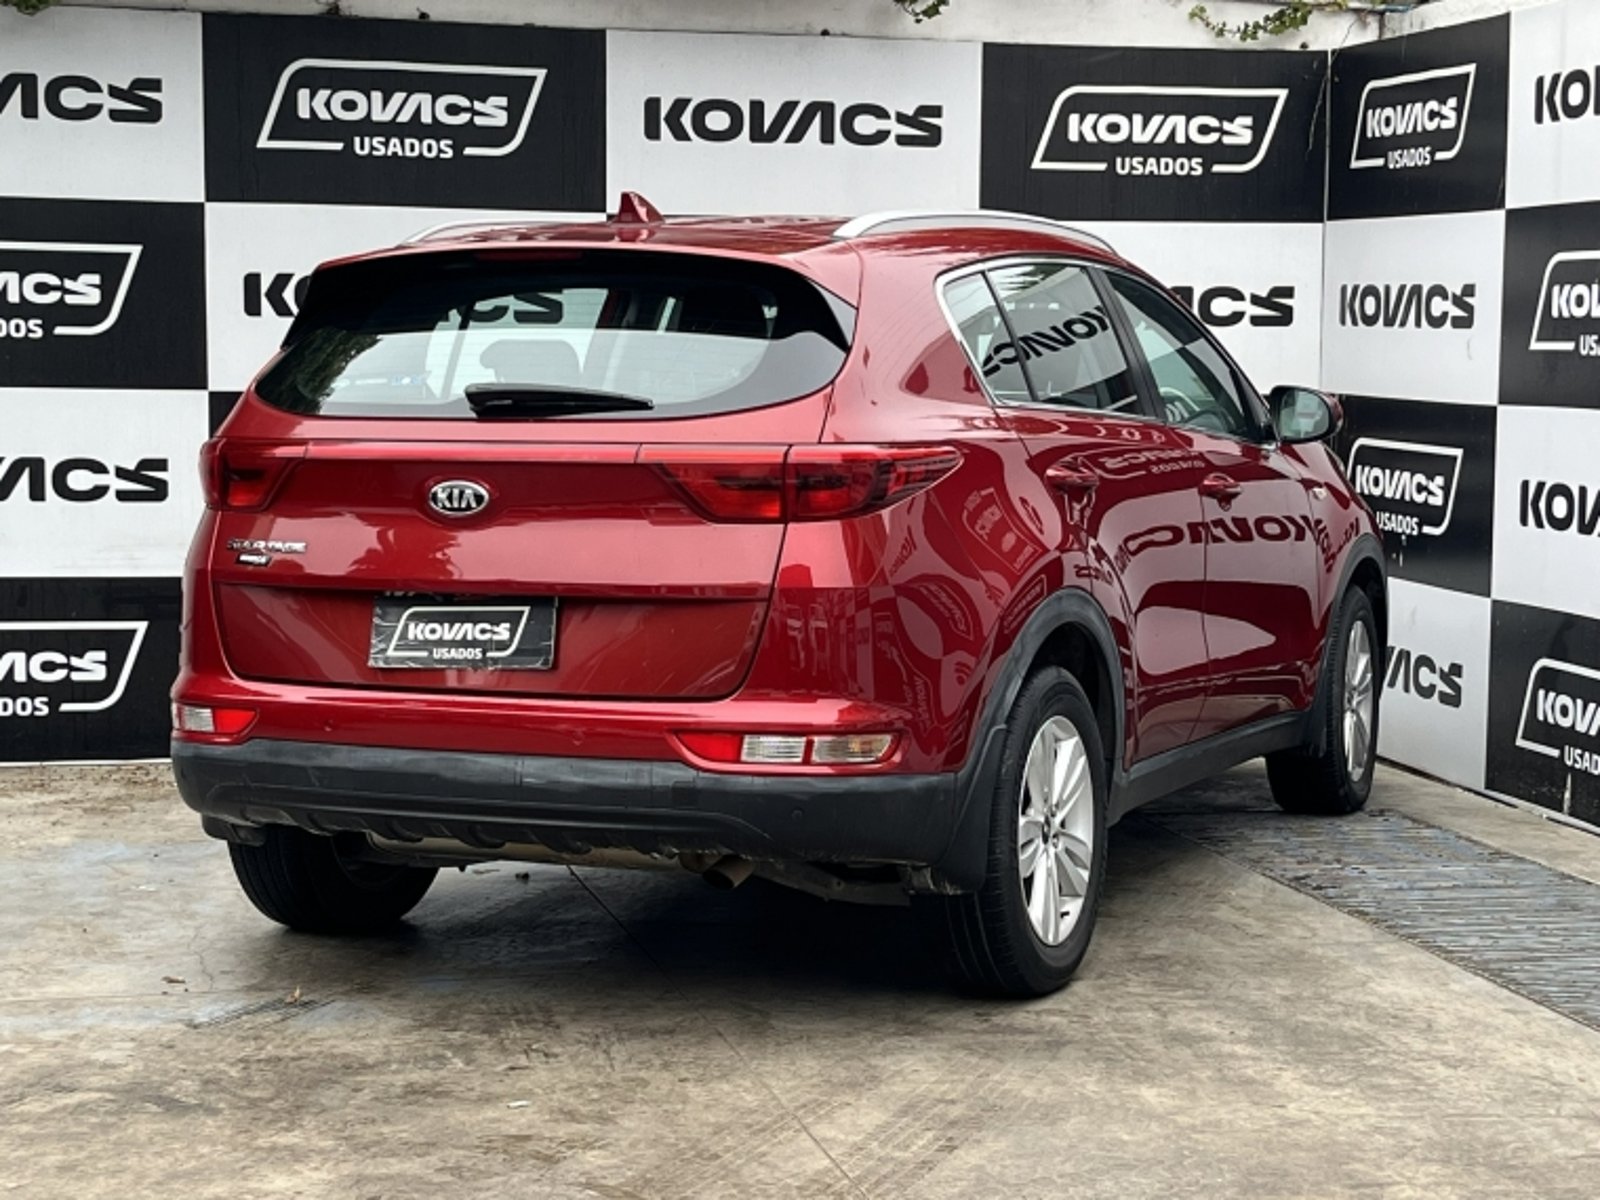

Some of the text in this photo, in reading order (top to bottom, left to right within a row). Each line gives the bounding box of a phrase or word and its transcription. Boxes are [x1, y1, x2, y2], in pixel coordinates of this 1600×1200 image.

[298, 89, 507, 126] KOVACS
[644, 97, 942, 147] KOVACS
[1366, 96, 1458, 139] KOVACS
[1068, 114, 1252, 144] KOVACS
[354, 137, 453, 158] USADOS
[1388, 146, 1431, 169] USADOS
[1116, 157, 1202, 175] USADOS
[1340, 284, 1475, 329] KOVACS
[1580, 335, 1600, 356] US
[0, 457, 168, 502] ACS
[1355, 465, 1446, 507] KOVACS
[436, 487, 477, 509] KIA
[1520, 480, 1600, 536] KOV
[1376, 512, 1418, 535] USADOS
[407, 622, 510, 642] KOVACS
[432, 647, 483, 660] USADOS
[1537, 689, 1600, 735] KOV
